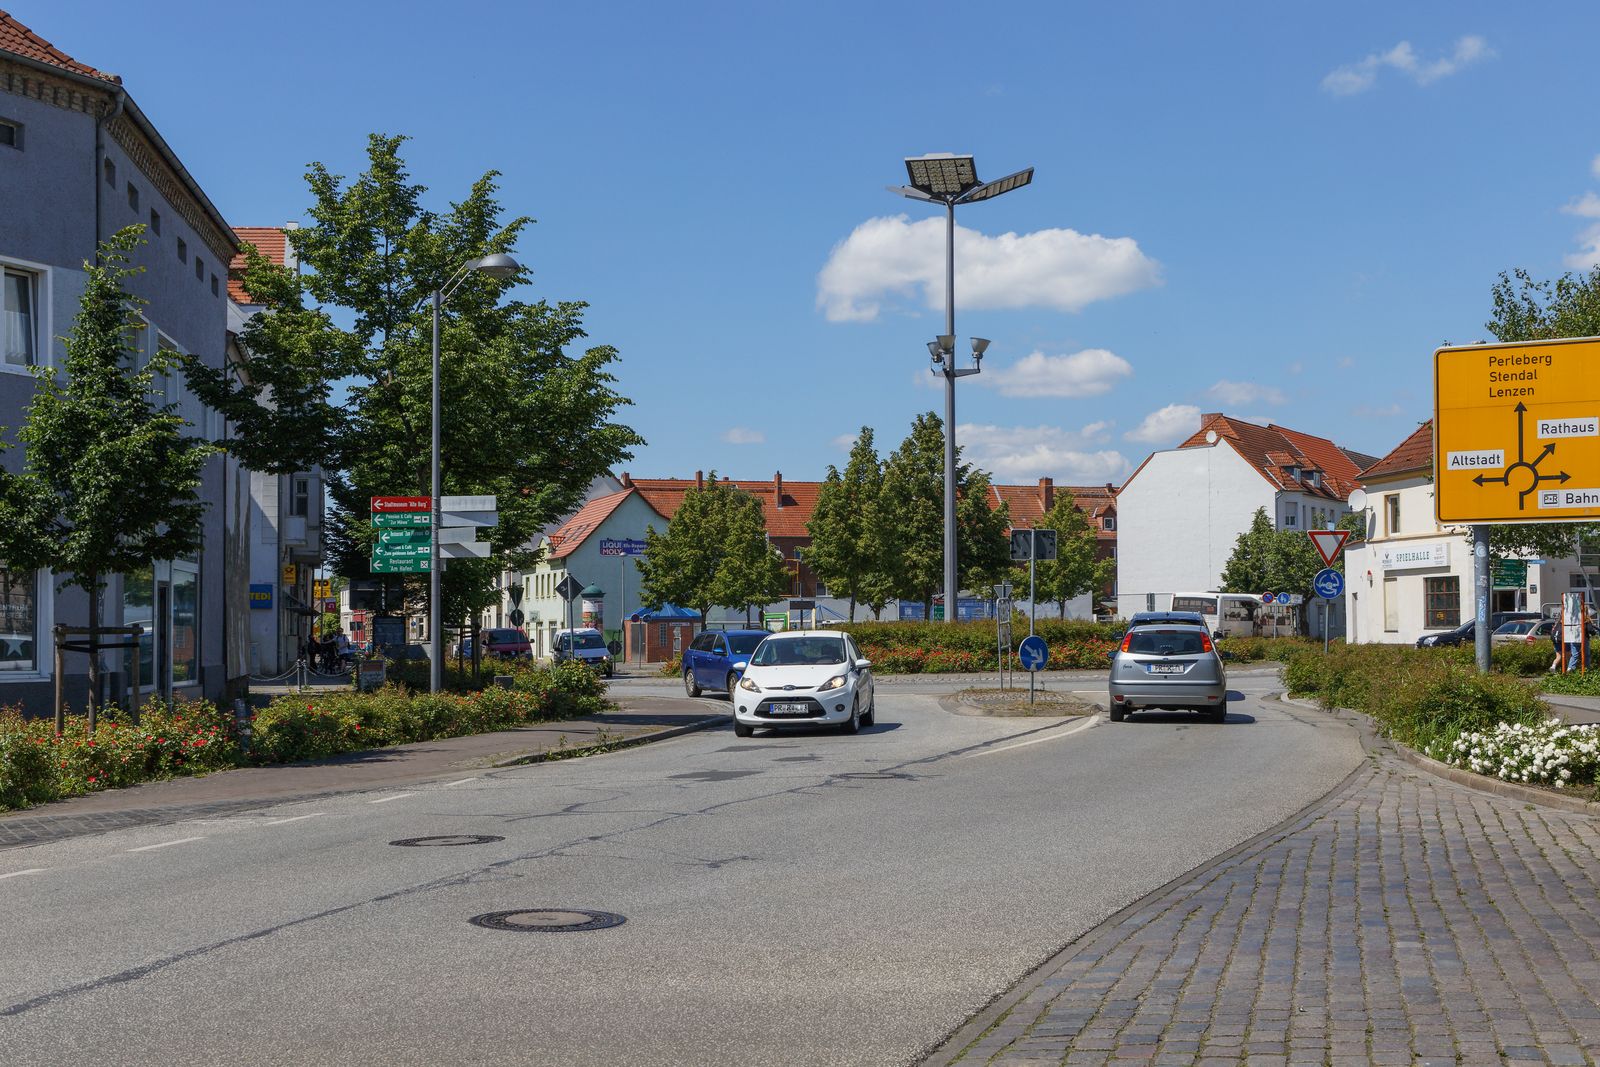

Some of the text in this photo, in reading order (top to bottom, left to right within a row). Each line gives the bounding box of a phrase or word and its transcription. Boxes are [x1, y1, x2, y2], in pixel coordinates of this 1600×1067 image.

[1488, 354, 1552, 367] Perleberg
[1489, 369, 1538, 383] Stendal
[1489, 387, 1535, 398] Lenzen
[1541, 422, 1595, 435] Rathaus
[1451, 454, 1501, 466] Altstadt
[1396, 551, 1430, 562] SPIELHALLE
